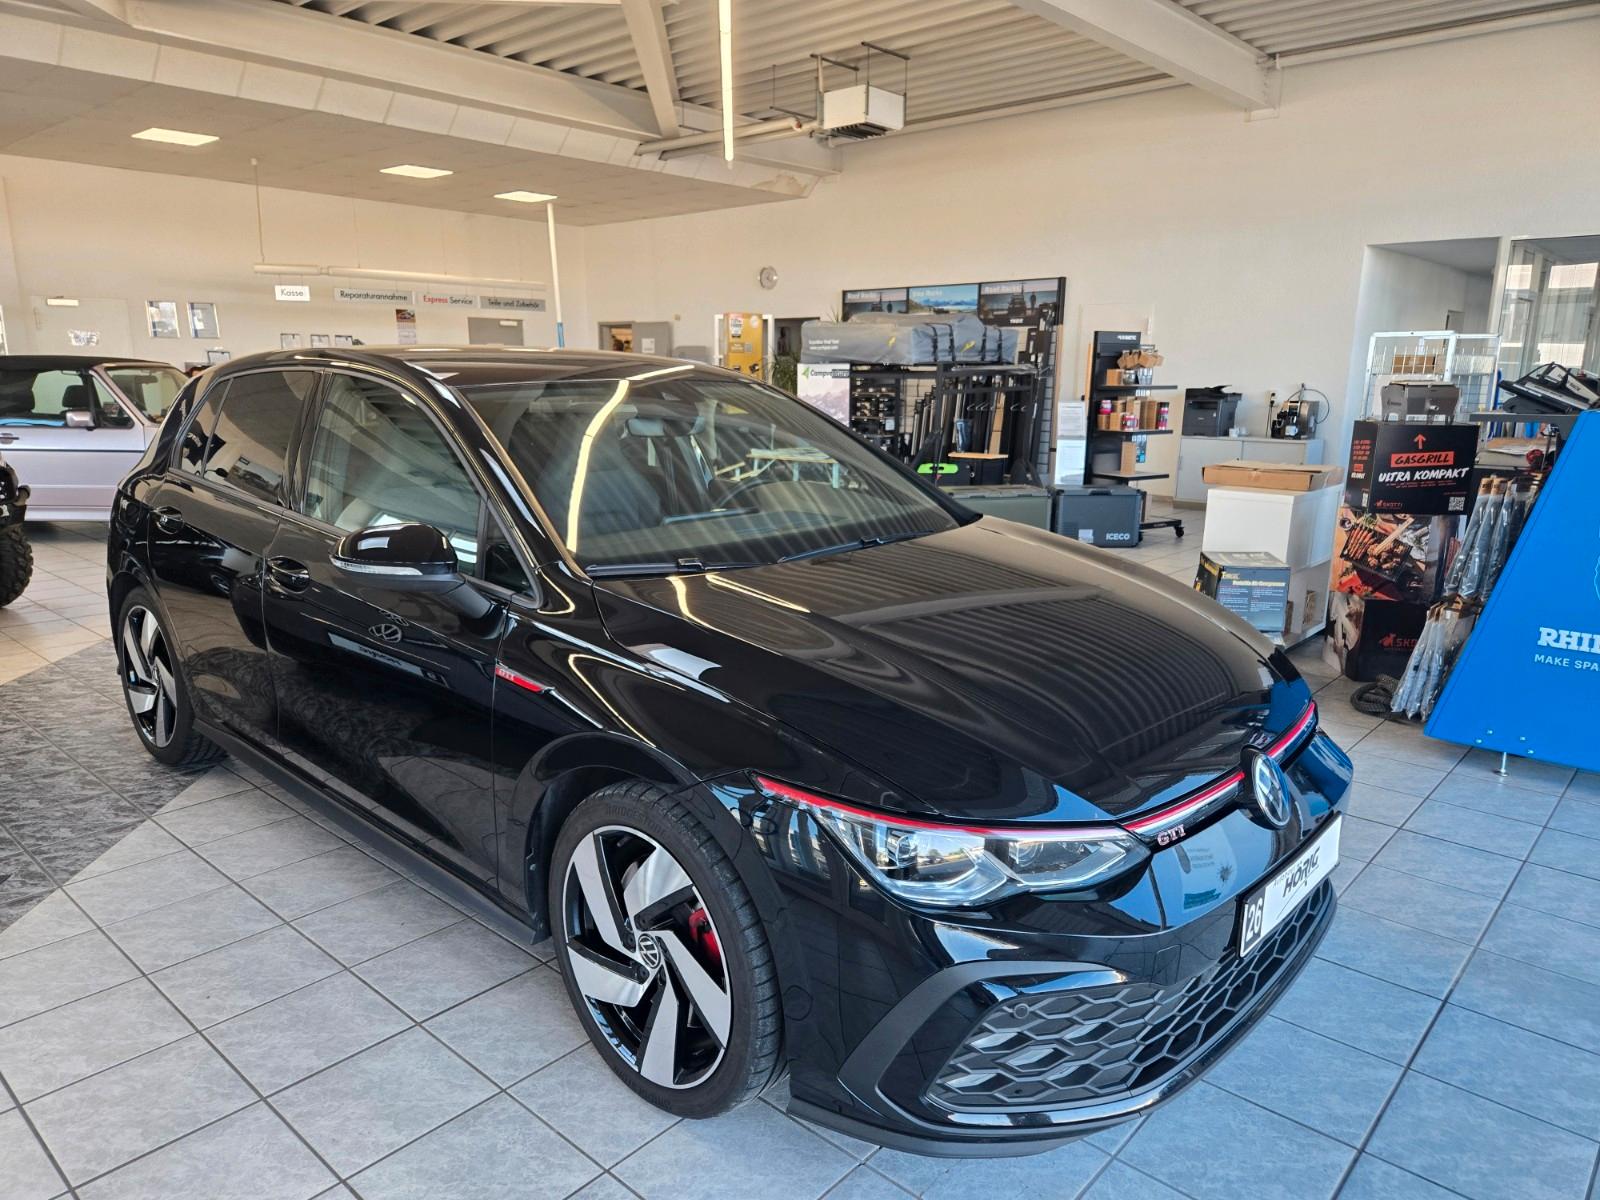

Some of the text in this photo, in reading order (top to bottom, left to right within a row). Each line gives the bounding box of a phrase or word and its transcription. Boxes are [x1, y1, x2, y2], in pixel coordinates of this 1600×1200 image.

[280, 288, 304, 298] Kasse
[339, 289, 408, 301] Reparaturannahme
[423, 295, 473, 305] Express Service
[502, 299, 515, 307] und
[1394, 454, 1450, 465] GASGRILL
[1378, 471, 1410, 483] ULTRA
[1413, 467, 1470, 481] KOMPAKT
[1105, 532, 1131, 541] ICECO
[1534, 653, 1600, 672] MAKE SPA
[1156, 824, 1187, 846] GTI
[1245, 897, 1263, 942] 26
